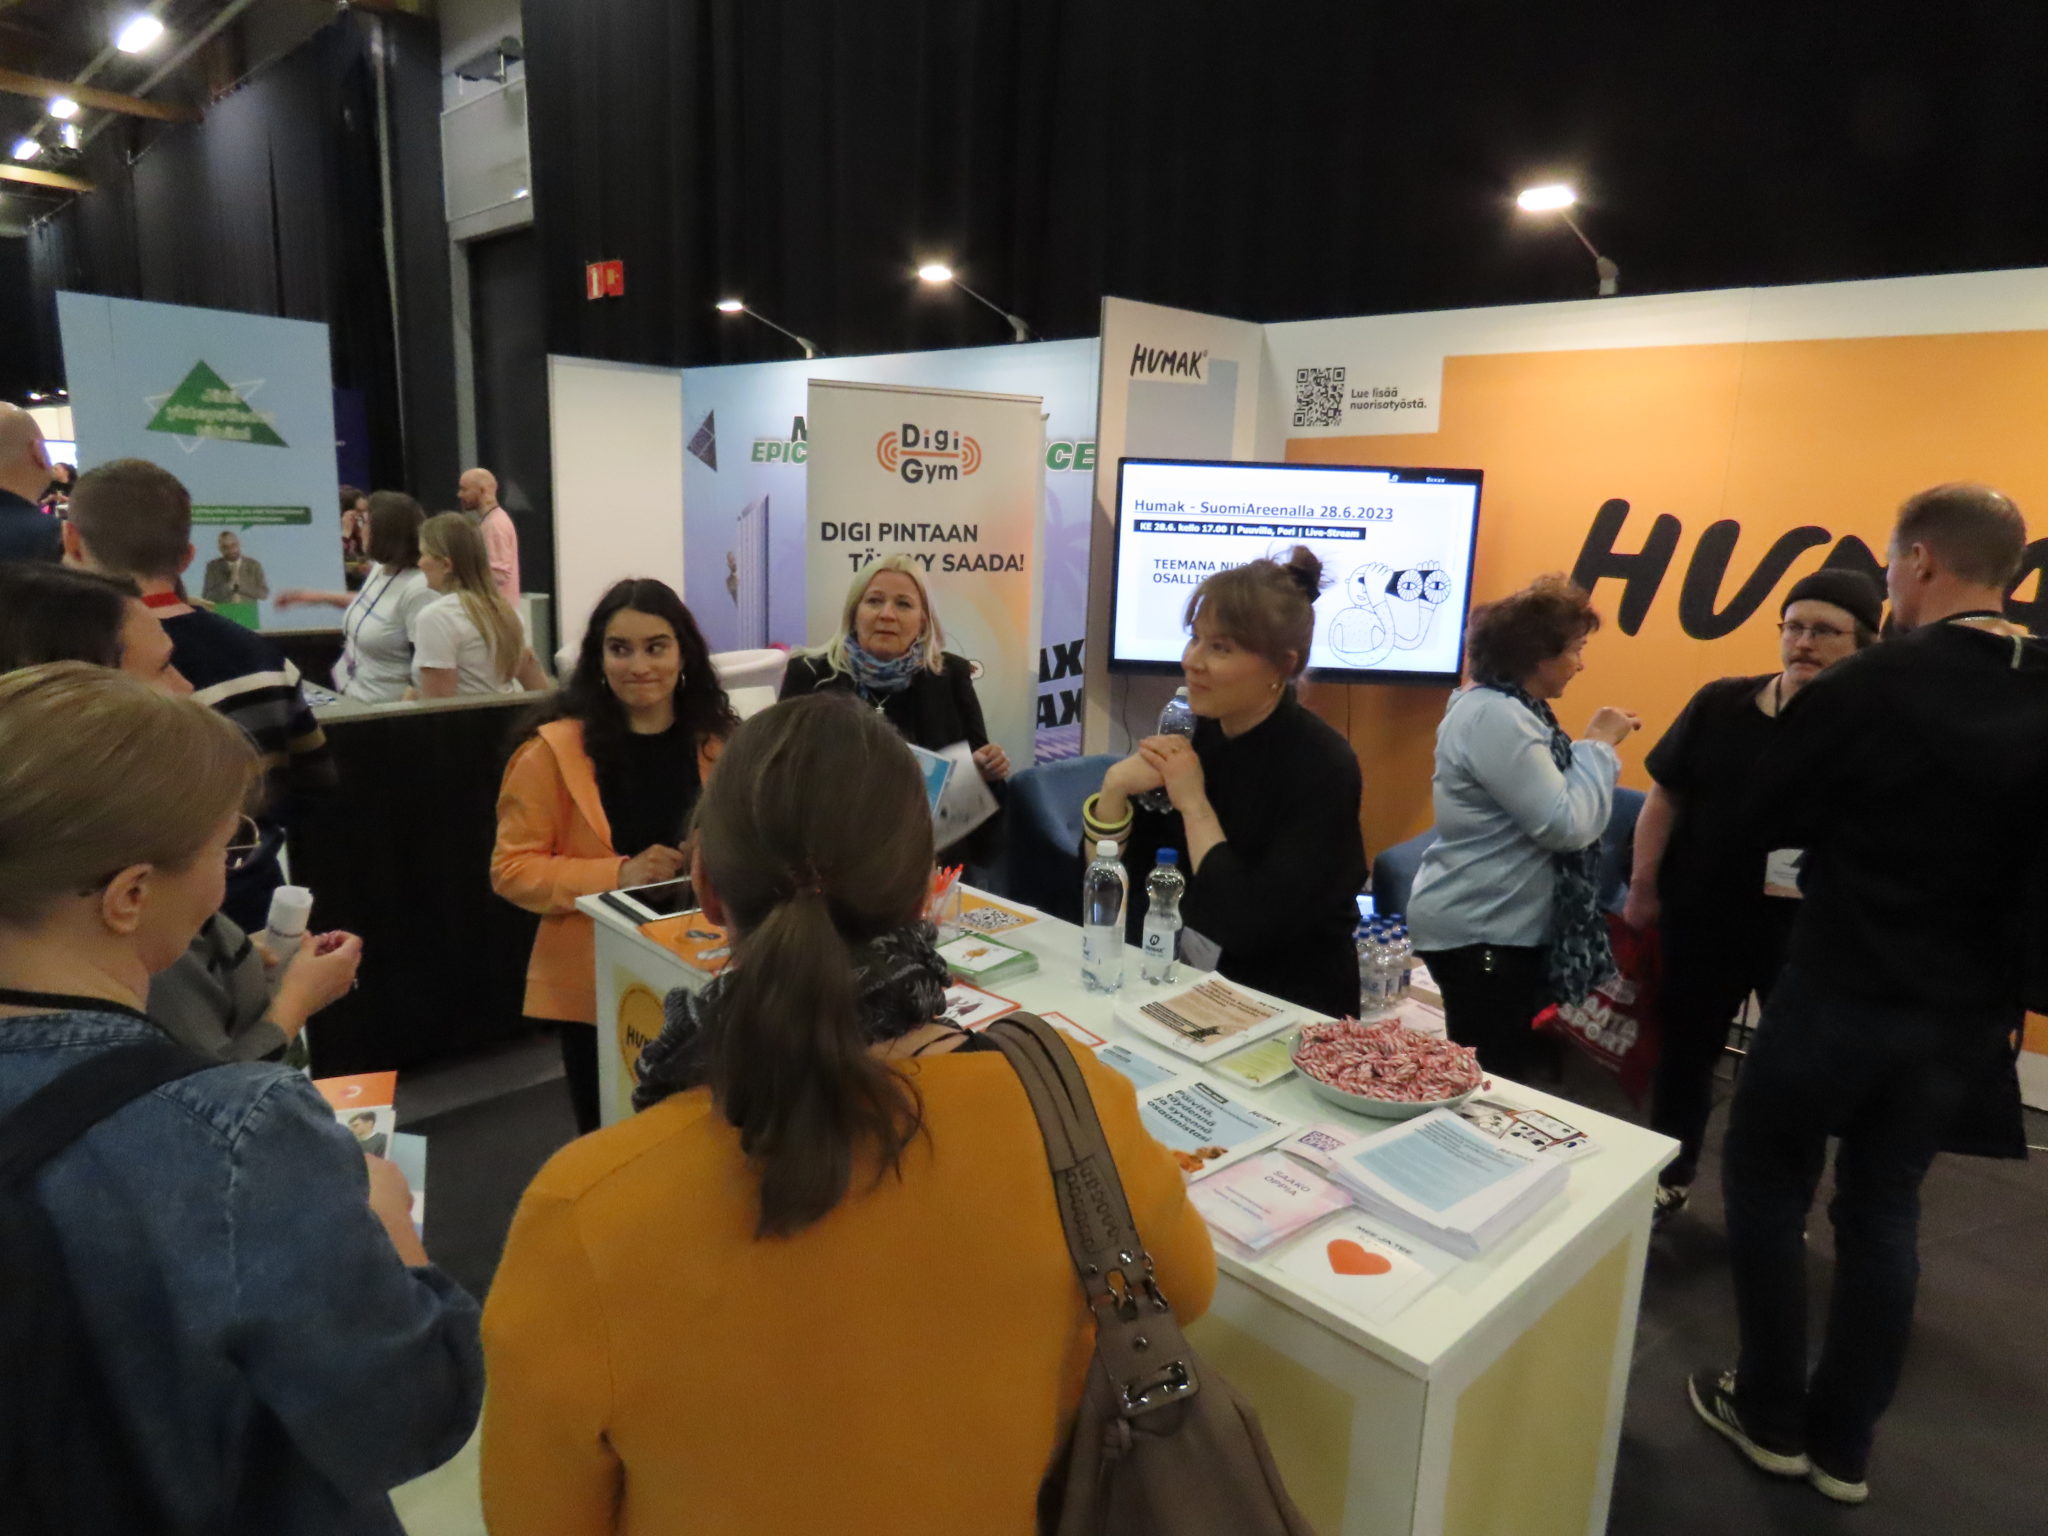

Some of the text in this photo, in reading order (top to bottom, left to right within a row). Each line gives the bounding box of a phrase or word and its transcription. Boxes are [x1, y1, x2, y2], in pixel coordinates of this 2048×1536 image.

[1130, 343, 1202, 379] HUMAK
[1351, 387, 1398, 398] Lue lisää
[1350, 398, 1427, 411] nuorisotyöstä.
[902, 423, 959, 450] Digi
[901, 458, 958, 483] Gym
[1135, 500, 1185, 512] Humak
[1200, 502, 1314, 517] SuomiAreenalla
[1320, 506, 1393, 519] 28.6.2023
[821, 522, 978, 542] DIGI PINTAAN
[1140, 522, 1152, 531] KE
[1154, 522, 1176, 531] 28.6.
[1178, 523, 1200, 532] kello
[1202, 524, 1227, 533] 17.00
[1277, 527, 1295, 535] Pori
[1305, 528, 1360, 538] Live-Stream
[942, 554, 1024, 572] SAADA!
[1154, 559, 1215, 571] TEEMANA
[1153, 1097, 1168, 1106] ja
[1167, 1094, 1216, 1127] täydennä
[1147, 1101, 1212, 1142] osaamistasi
[1264, 1176, 1297, 1196] OPPIA
[1272, 1170, 1311, 1192] SAAKO
